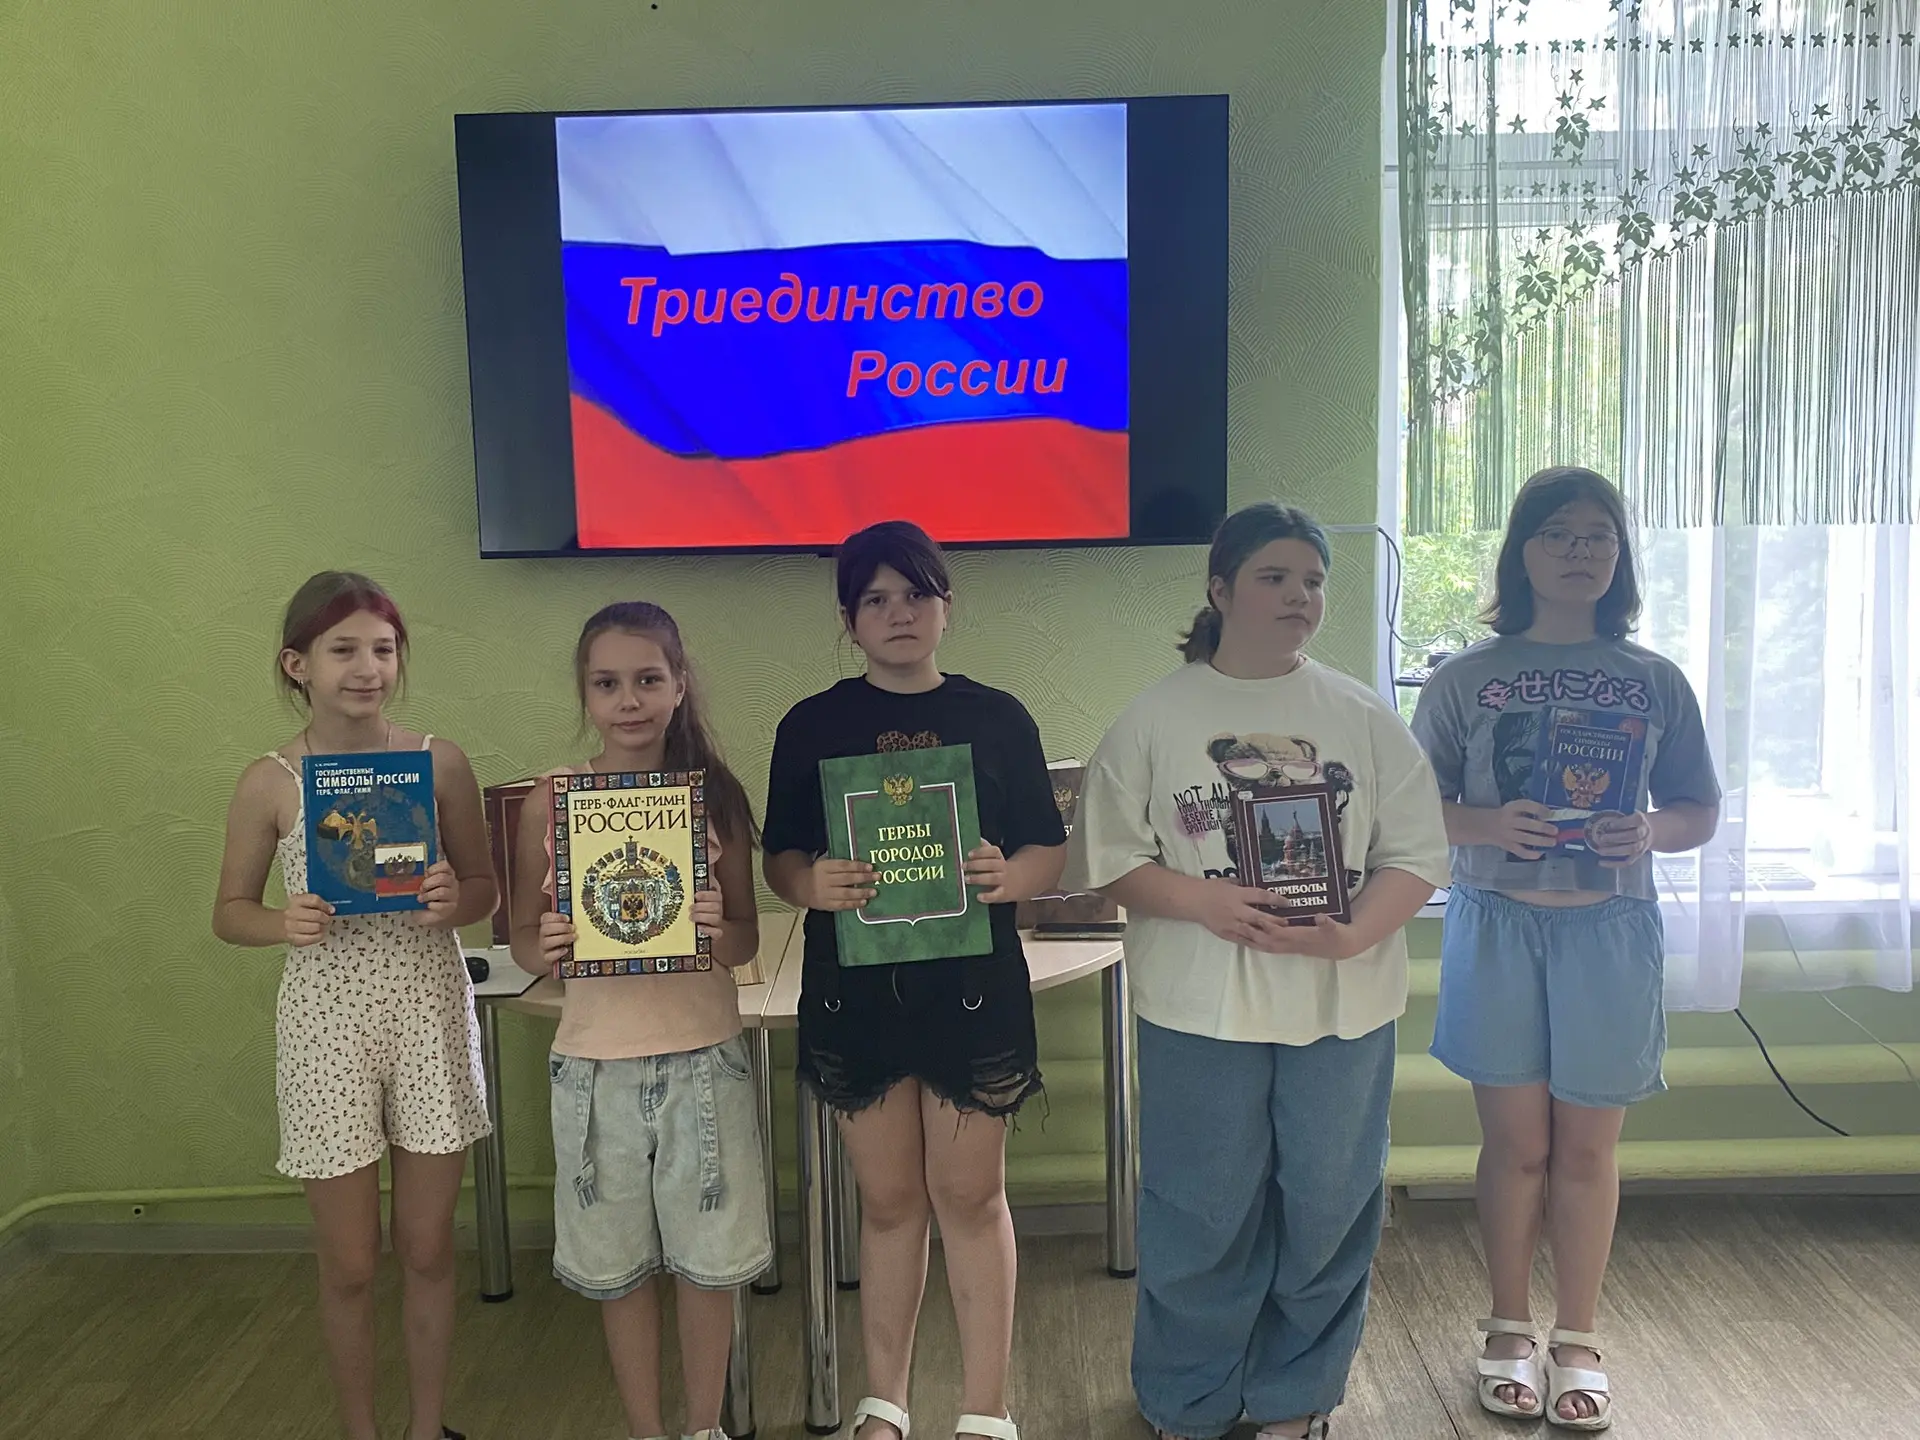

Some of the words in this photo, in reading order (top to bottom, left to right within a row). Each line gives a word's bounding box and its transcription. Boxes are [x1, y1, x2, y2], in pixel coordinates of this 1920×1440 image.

[620, 272, 1044, 336] Триединство
[846, 349, 1069, 398] России
[1477, 669, 1651, 712] 幸せになる
[1557, 742, 1625, 762] РОССИИ
[316, 775, 373, 788] СИМВОЛЫ
[376, 772, 420, 785] РОССИИ
[1172, 785, 1202, 809] NOT
[573, 808, 688, 834] РОССИИ
[878, 823, 932, 842] ГЕРБЫ
[869, 843, 945, 864] ГОРОДОВ
[874, 864, 945, 886] ОССИИ
